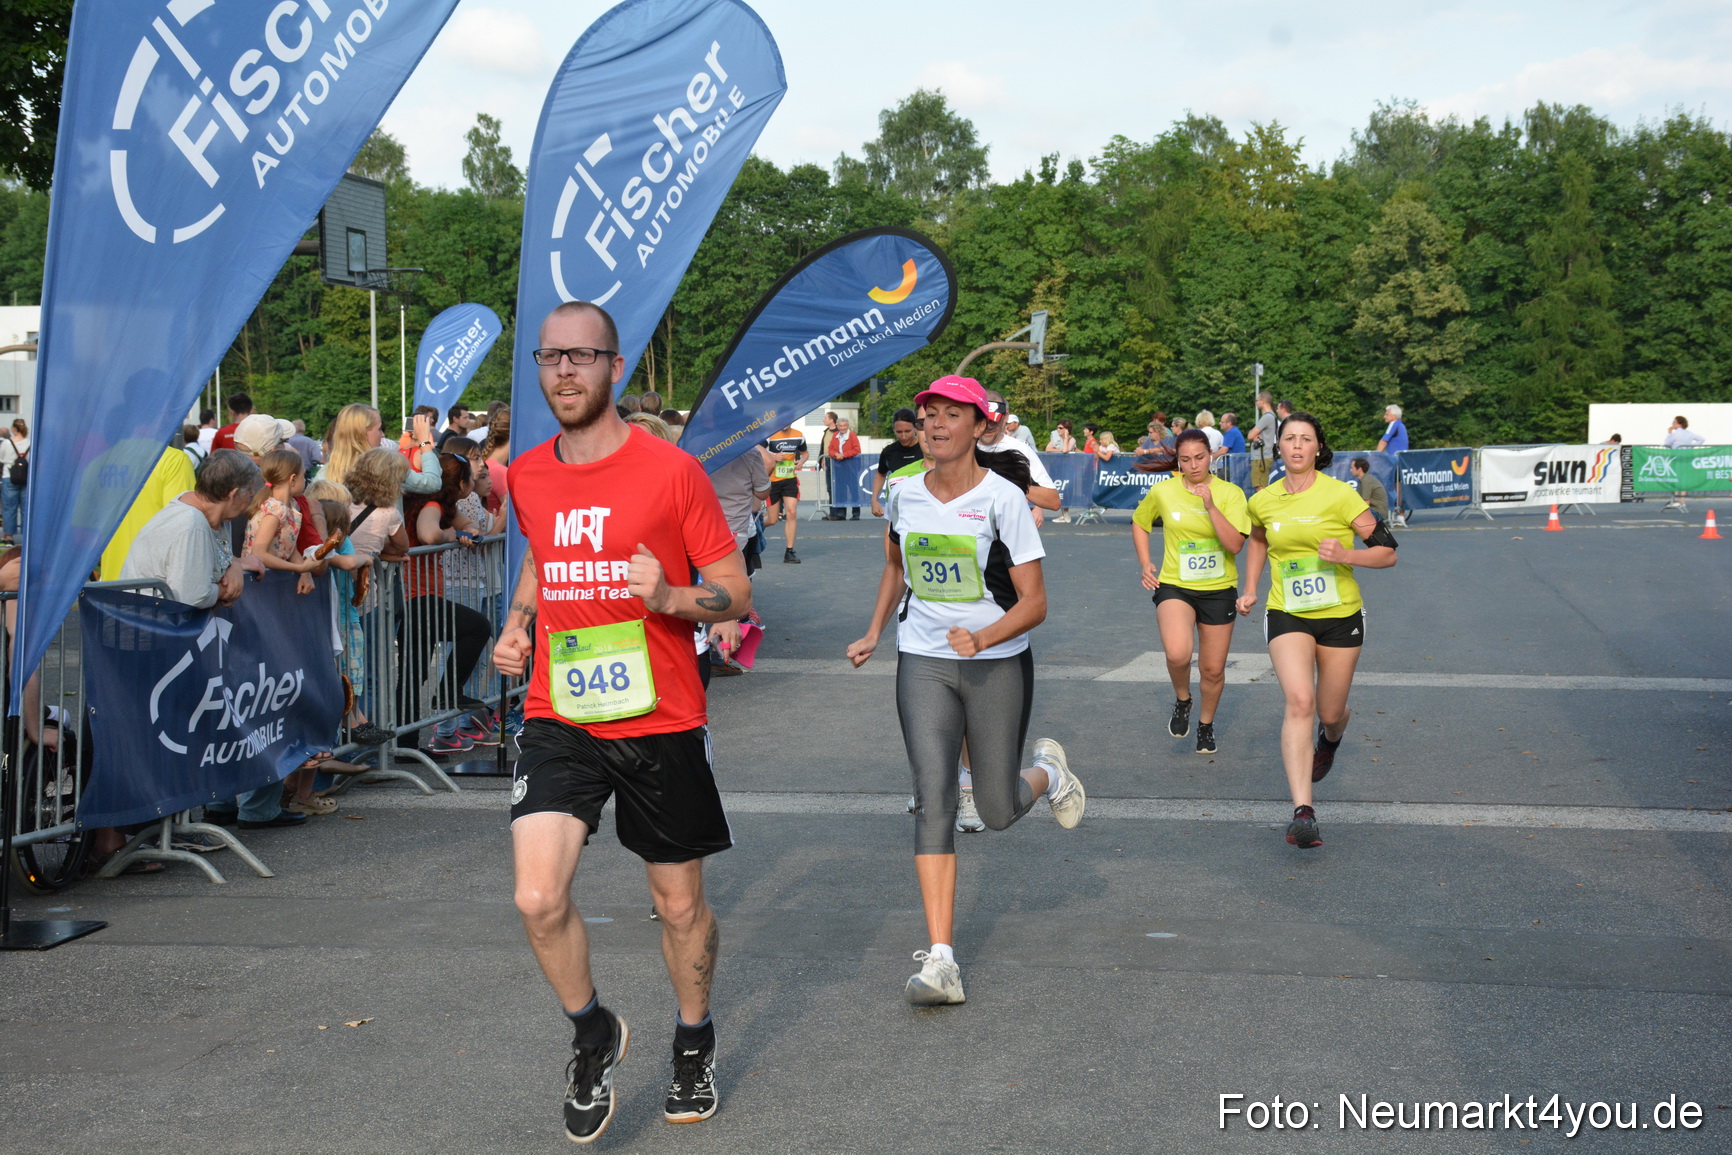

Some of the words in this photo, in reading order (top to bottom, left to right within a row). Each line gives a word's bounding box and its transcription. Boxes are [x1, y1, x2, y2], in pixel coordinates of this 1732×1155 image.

[168, 0, 333, 189] Fisc
[250, 0, 390, 189] AUTOMOB
[584, 40, 729, 272] Fischer
[636, 85, 746, 269] AUTOMOBILE
[436, 318, 484, 383] Fischer
[453, 330, 488, 382] AUTOMOBILE
[827, 339, 868, 368] Druck
[868, 326, 895, 345] und
[894, 299, 941, 334] Medien
[720, 307, 886, 410] Frischmann
[695, 408, 778, 464] ischmann-net.de
[1401, 467, 1453, 485] Frischmann
[1533, 460, 1587, 486] swn
[1639, 455, 1678, 477] AOK
[554, 506, 611, 553] MRT
[543, 561, 630, 583] MEIER
[921, 561, 962, 584] 391
[1188, 555, 1217, 570] 625
[542, 586, 595, 601] Running
[597, 586, 634, 600] Tea
[1292, 576, 1326, 597] 650
[567, 662, 631, 697] 948
